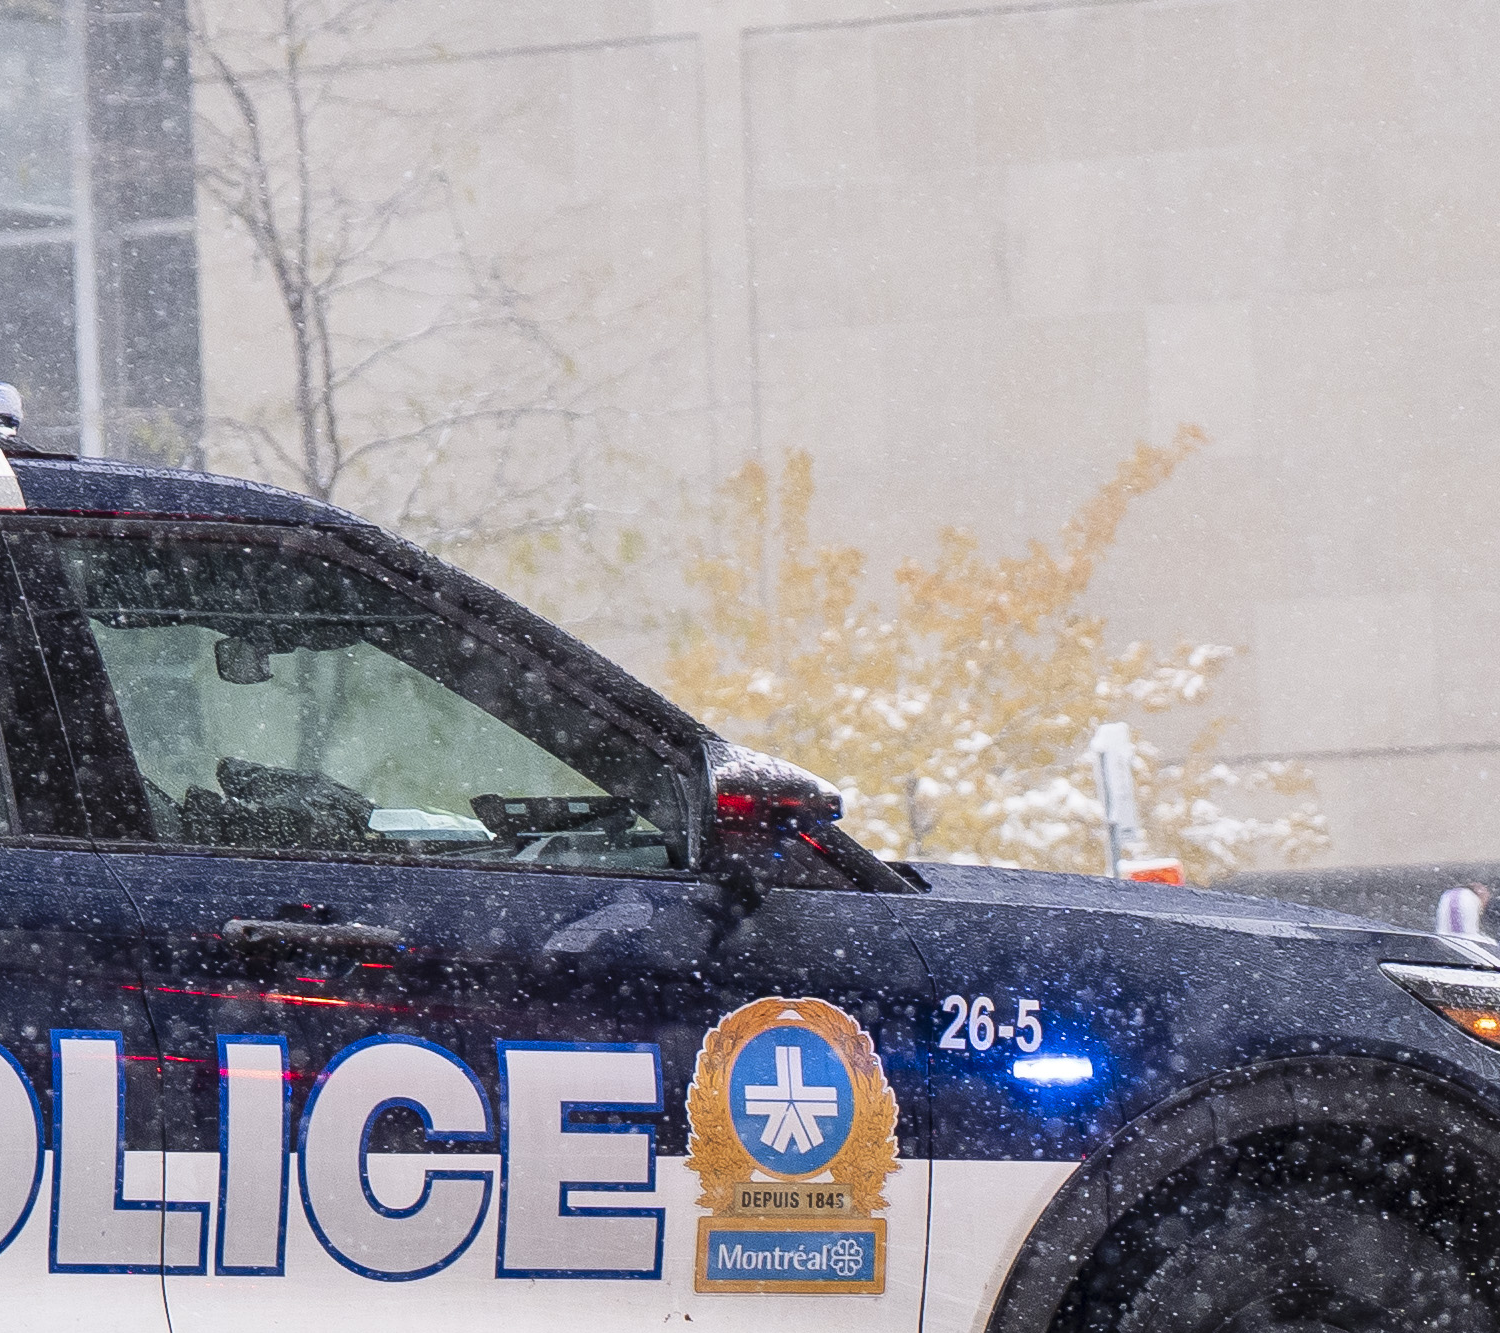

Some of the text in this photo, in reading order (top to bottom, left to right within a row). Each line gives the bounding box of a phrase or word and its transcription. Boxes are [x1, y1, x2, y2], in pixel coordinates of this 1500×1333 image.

[938, 994, 1043, 1053] 26-5
[741, 1191, 845, 1209] DEPUIS 1843
[717, 1243, 829, 1271] Montréal
